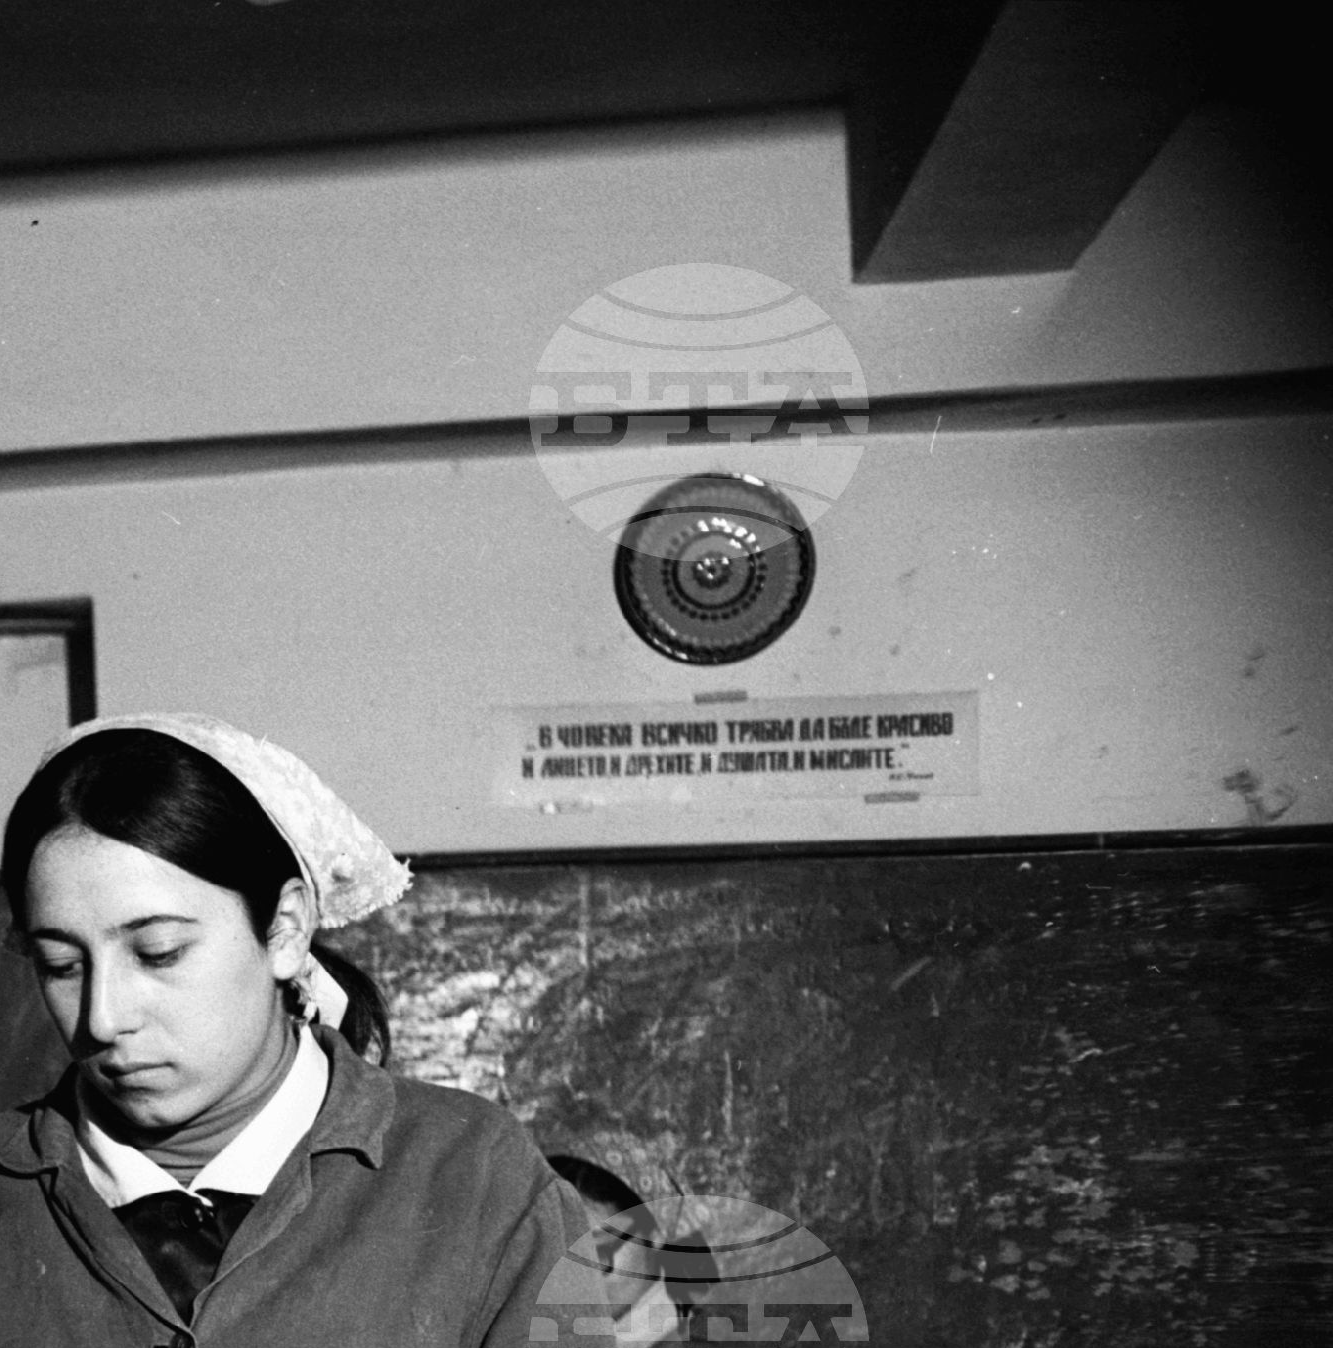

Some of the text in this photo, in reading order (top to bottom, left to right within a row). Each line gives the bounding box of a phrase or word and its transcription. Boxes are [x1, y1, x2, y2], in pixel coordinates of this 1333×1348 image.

[557, 722, 632, 748] ЧОВЕКА
[641, 720, 718, 746] ВСИЧКО
[724, 717, 794, 743] ТРЯБВА
[799, 716, 825, 741] ДА
[828, 714, 872, 740] БЪДЕ
[877, 712, 953, 738] КРАСИВО
[521, 756, 534, 779] И
